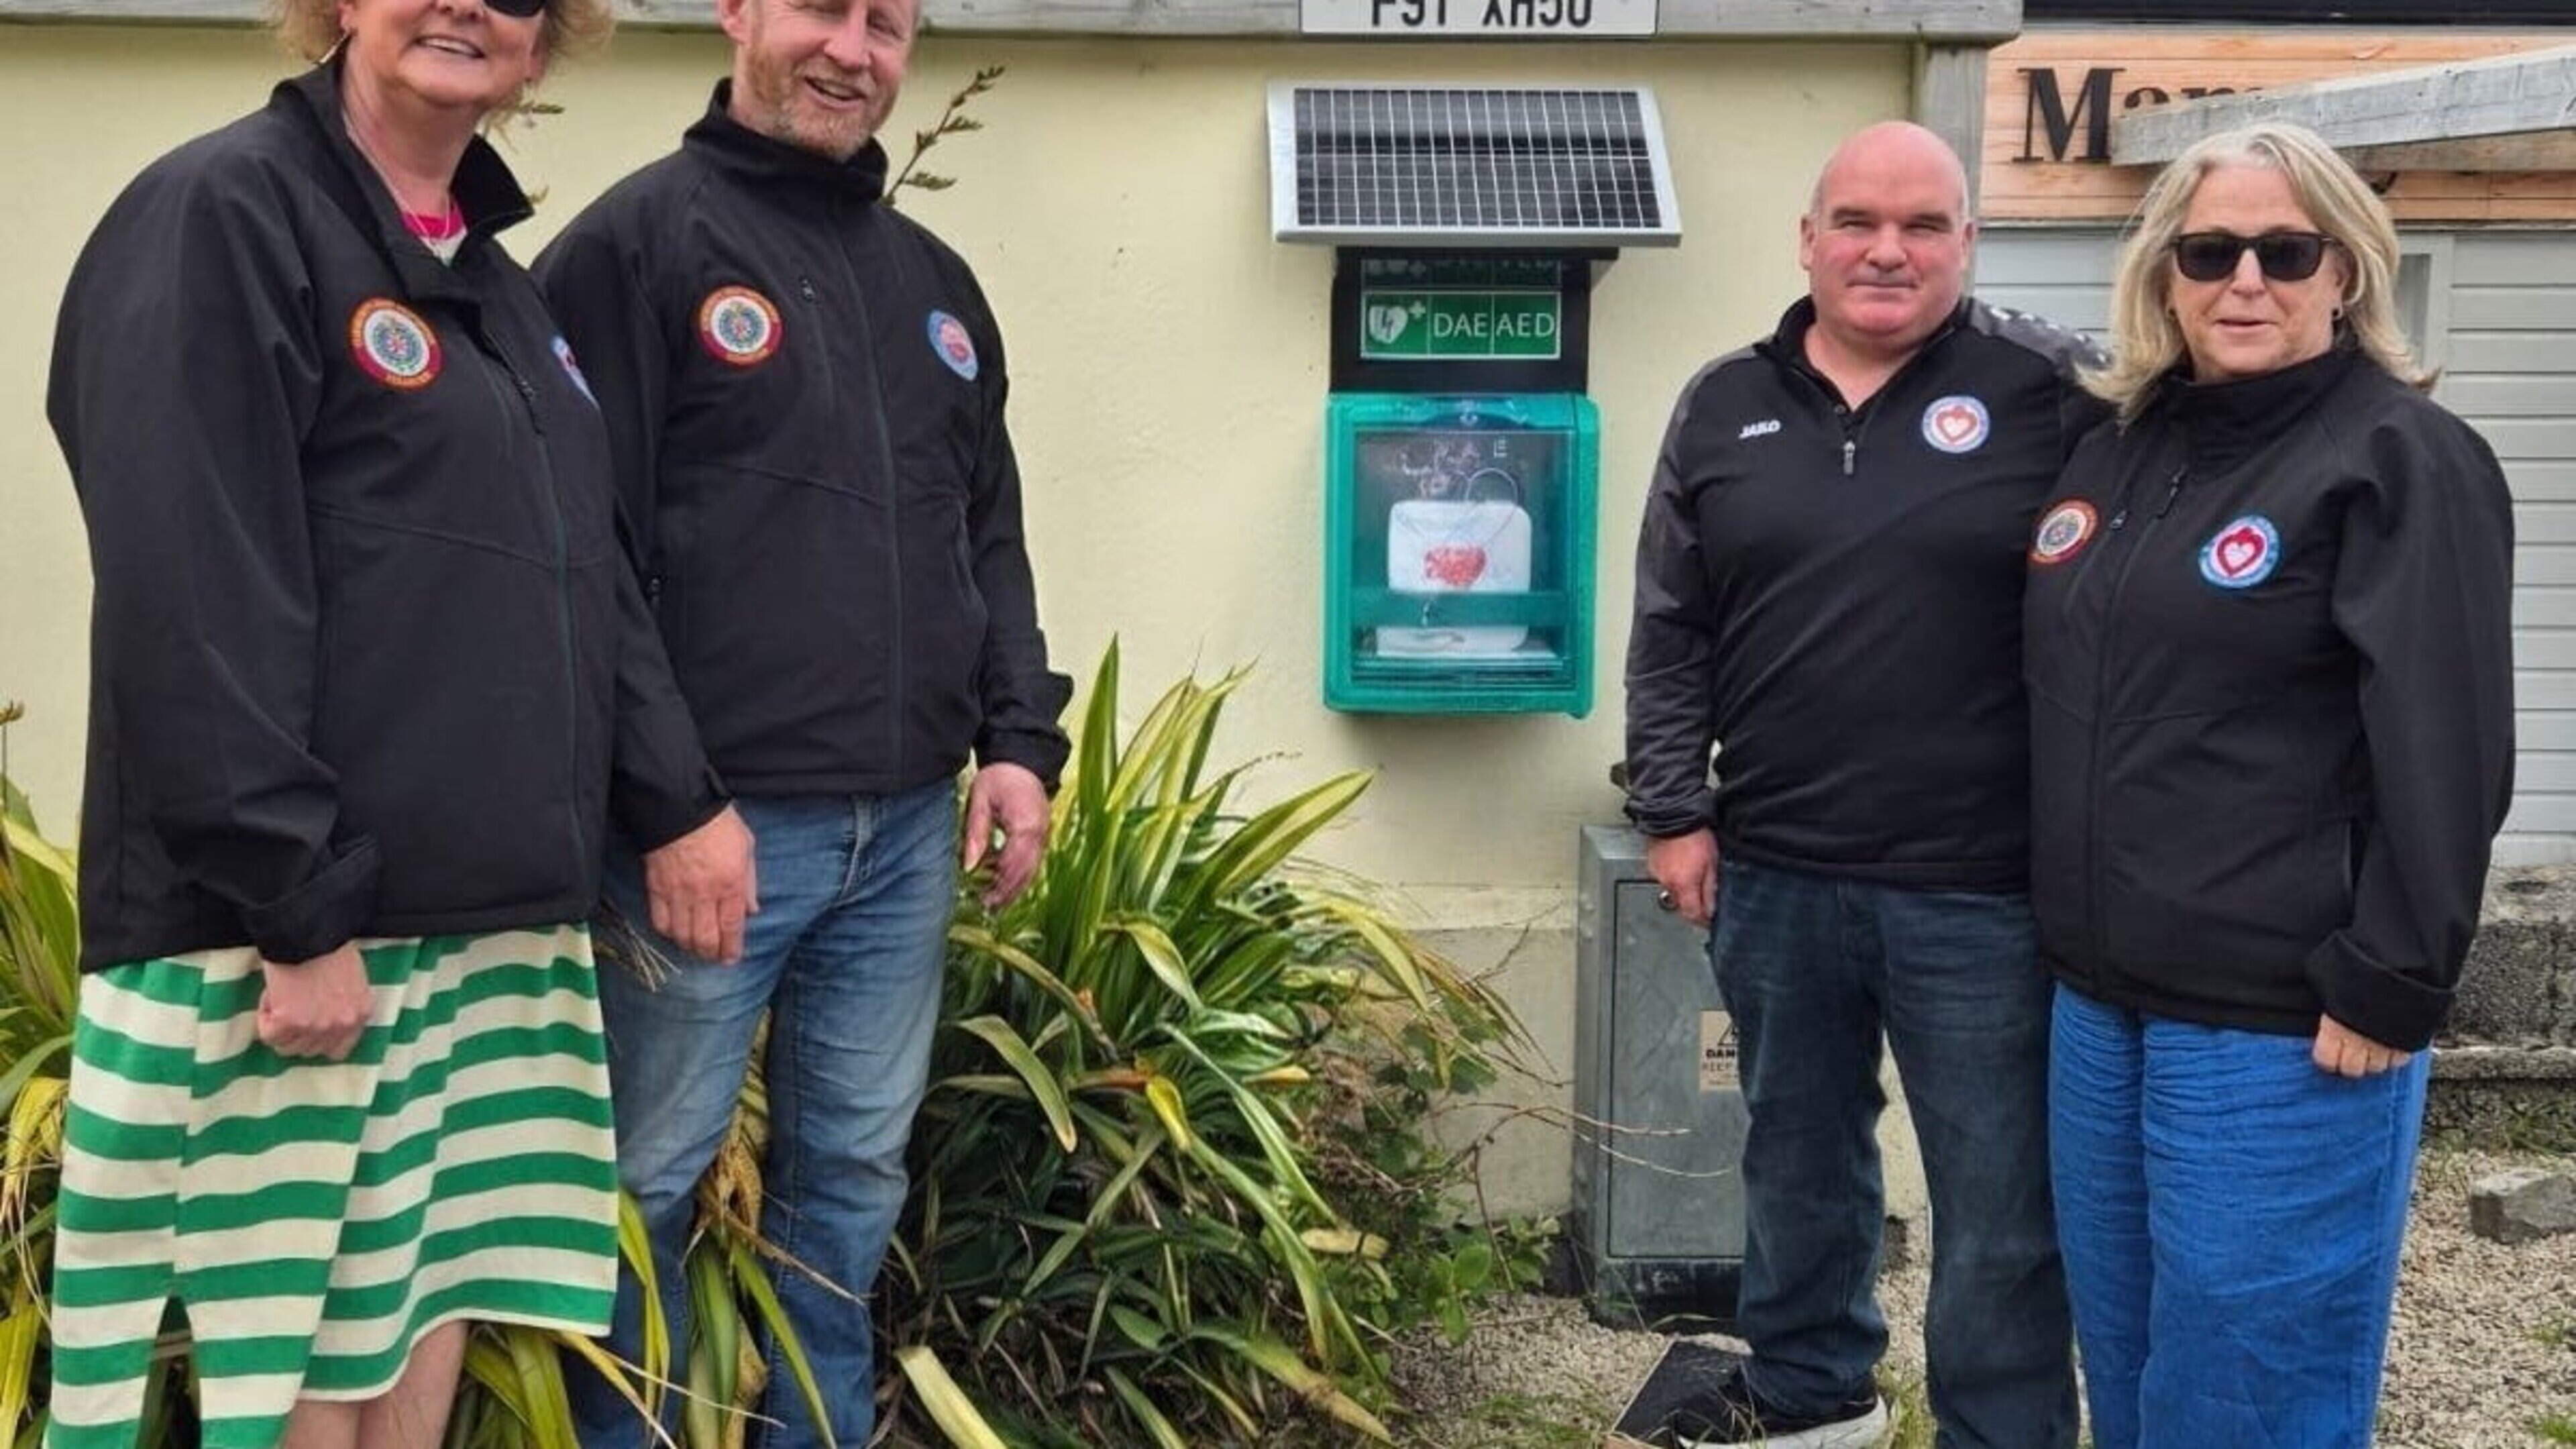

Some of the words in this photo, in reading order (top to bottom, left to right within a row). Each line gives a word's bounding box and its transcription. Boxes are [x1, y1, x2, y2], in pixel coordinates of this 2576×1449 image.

[1433, 312, 1489, 337] DAE
[1495, 312, 1555, 337] AED
[1705, 1049, 1736, 1059] DAN
